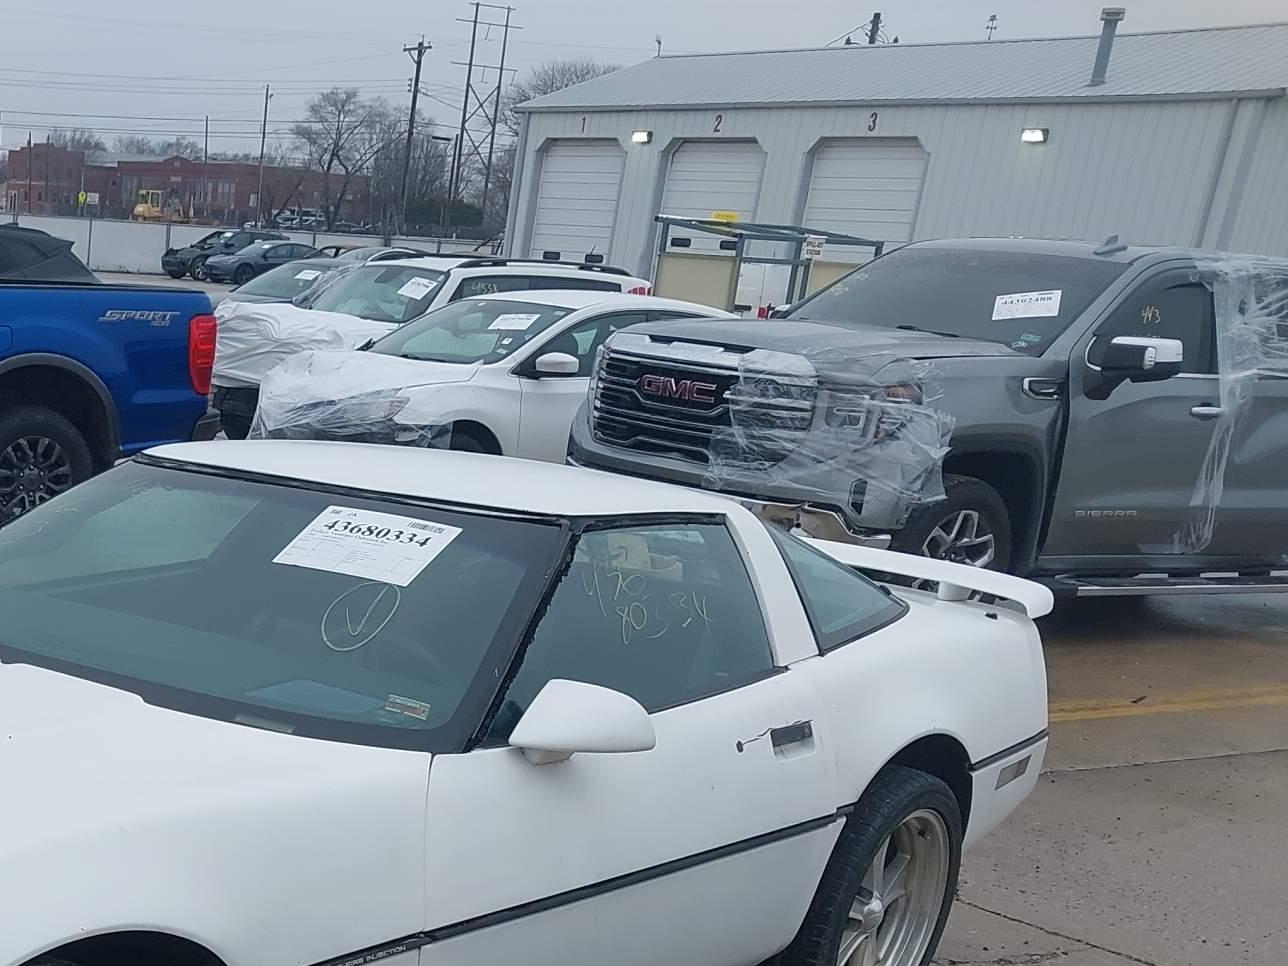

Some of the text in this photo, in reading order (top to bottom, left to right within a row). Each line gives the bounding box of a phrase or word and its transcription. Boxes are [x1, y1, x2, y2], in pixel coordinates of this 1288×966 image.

[582, 115, 586, 133] 1
[713, 115, 722, 132] 2
[868, 112, 878, 132] 3
[97, 310, 181, 323] SPORT
[642, 374, 717, 403] GMC
[323, 519, 433, 548] 43680334
[366, 945, 407, 962] INJECTION
